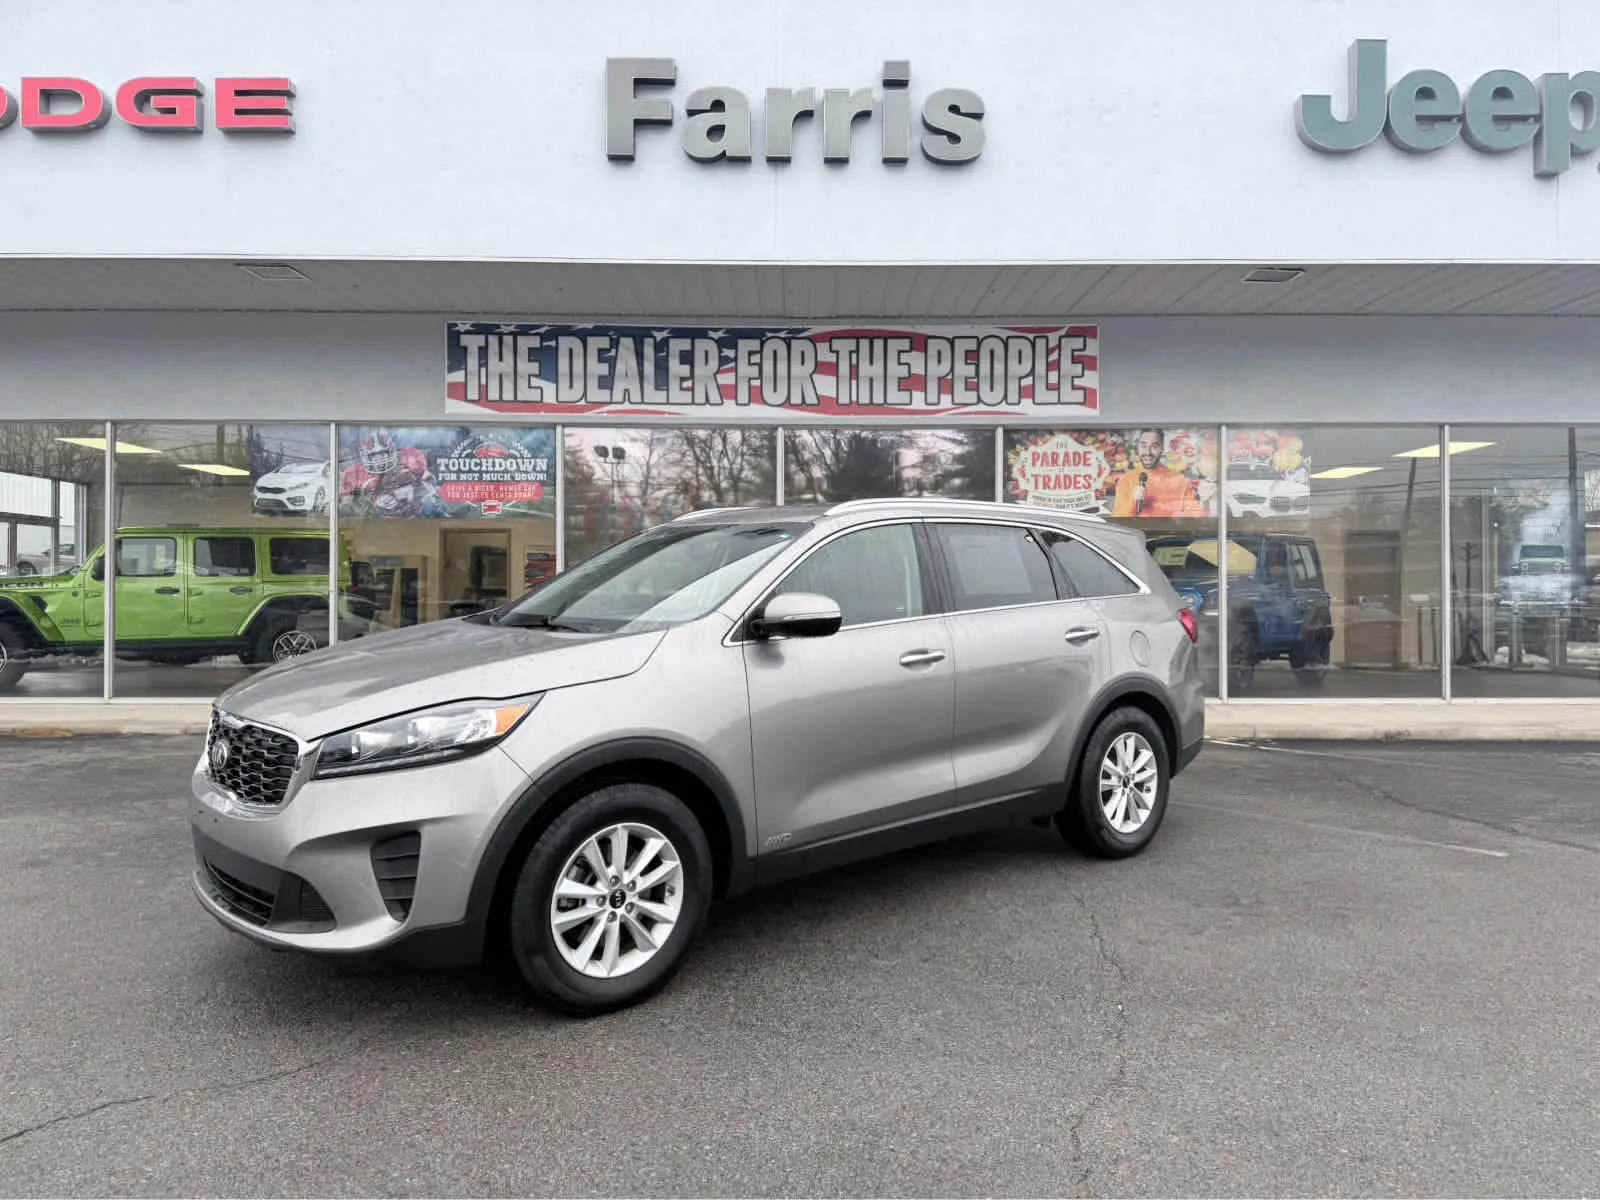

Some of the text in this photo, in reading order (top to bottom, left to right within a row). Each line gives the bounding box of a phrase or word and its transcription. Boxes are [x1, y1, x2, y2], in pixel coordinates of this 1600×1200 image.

[604, 56, 987, 165] Farris
[1294, 38, 1600, 177] Jeep
[459, 333, 1087, 406] THE DEALER FOR THE PEOPLE
[437, 458, 549, 471] TOUCHDOWN
[1031, 451, 1092, 468] PARADE
[438, 473, 547, 481] FOR NOT MUCH DOWN!
[1031, 474, 1093, 490] TRADES
